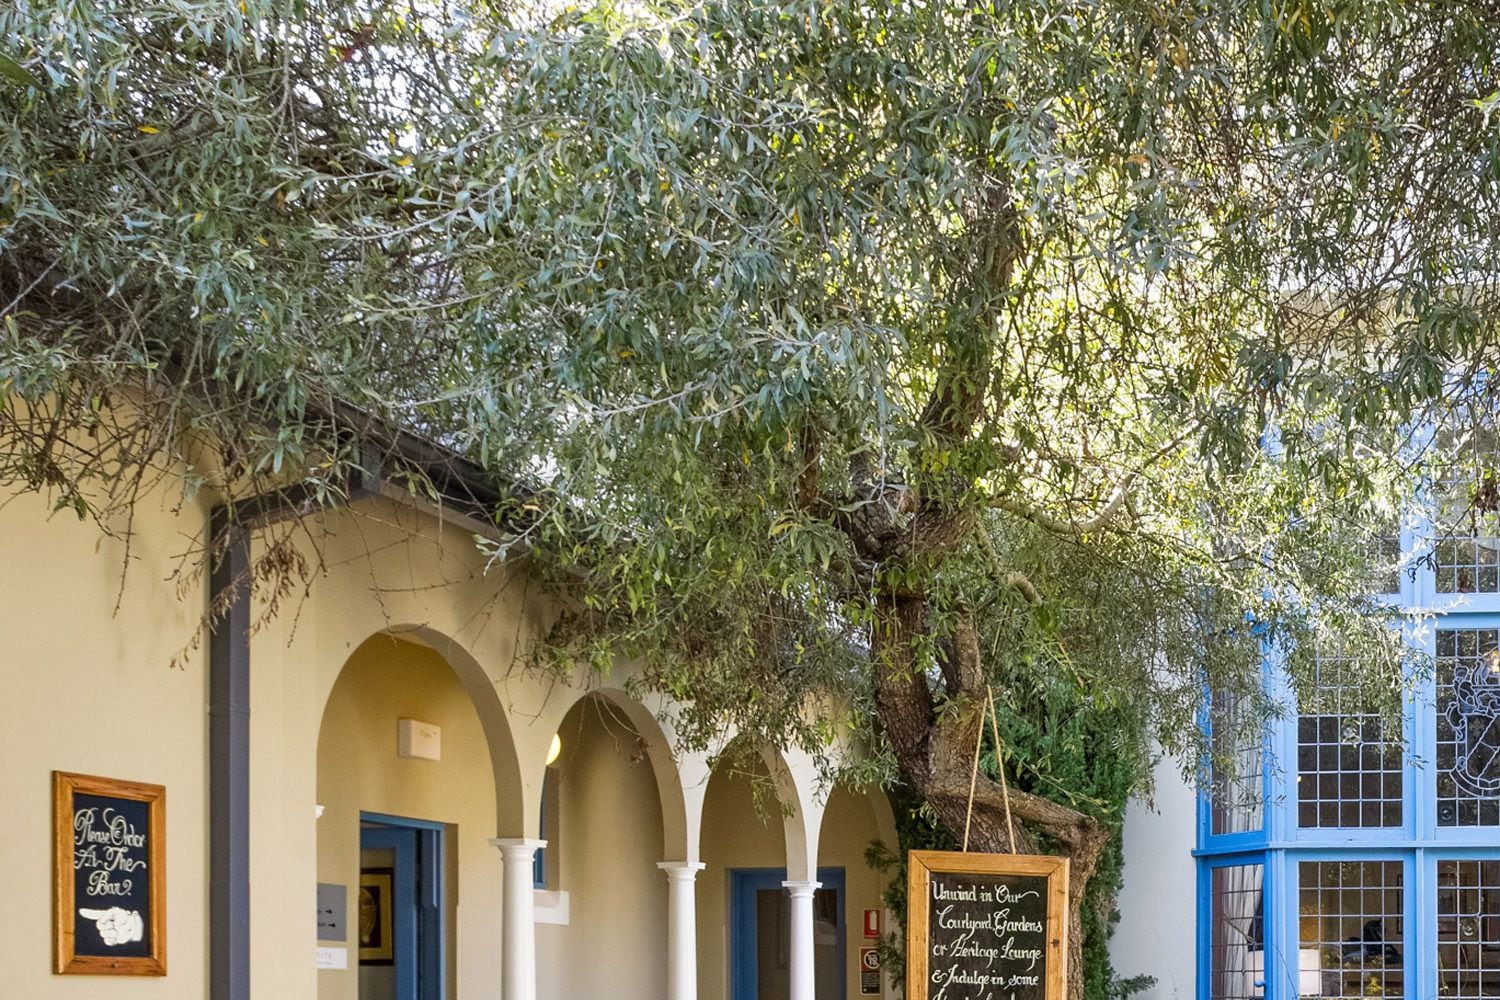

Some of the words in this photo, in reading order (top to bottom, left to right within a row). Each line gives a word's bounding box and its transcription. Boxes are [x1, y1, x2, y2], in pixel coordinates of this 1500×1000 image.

[74, 807, 110, 845] Please
[103, 807, 146, 847] Order
[74, 845, 103, 869] At
[103, 846, 146, 872] The
[931, 880, 977, 902] Unwind
[980, 885, 993, 902] in
[994, 884, 1040, 904] Our
[993, 908, 1043, 938] Gardens
[933, 944, 948, 956] or
[950, 933, 999, 968] Heritage
[1000, 936, 1044, 972] Lounge
[931, 969, 948, 983] &
[943, 964, 990, 997] Indulge
[991, 970, 1004, 985] in
[1003, 974, 1040, 990] some
